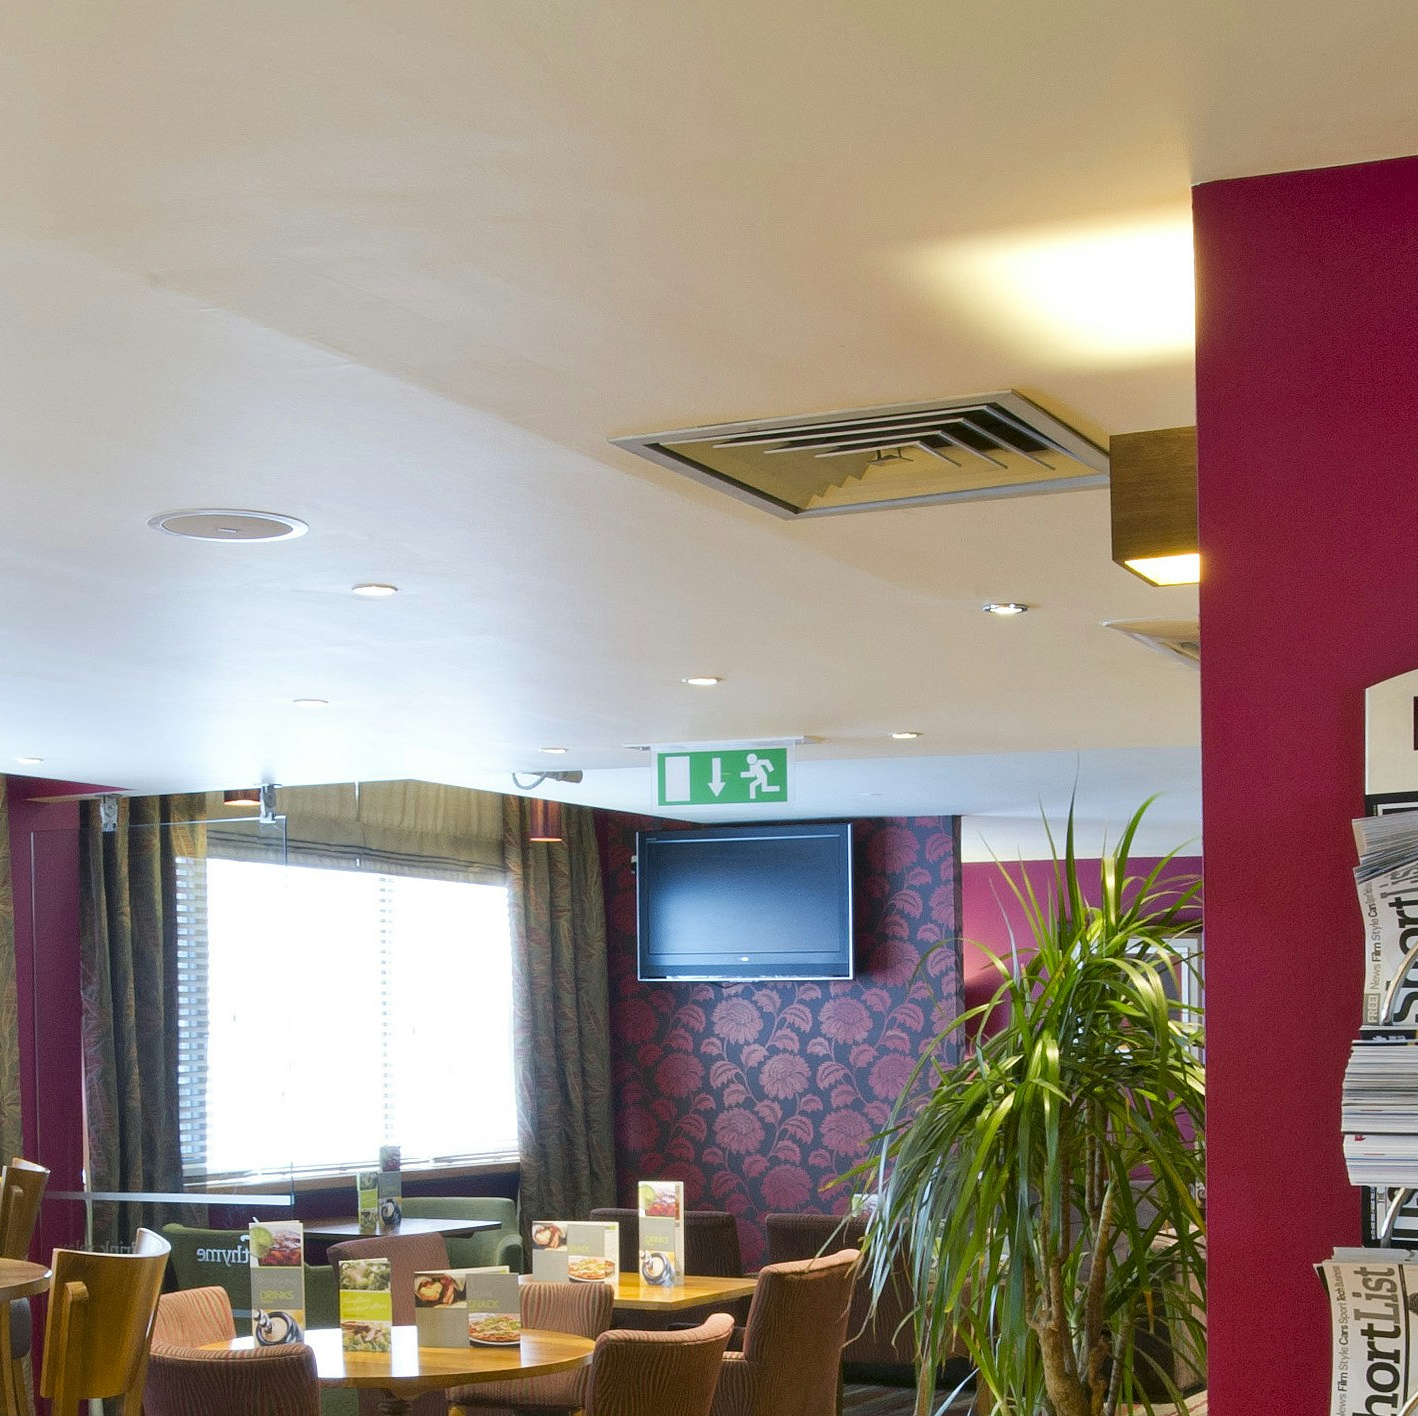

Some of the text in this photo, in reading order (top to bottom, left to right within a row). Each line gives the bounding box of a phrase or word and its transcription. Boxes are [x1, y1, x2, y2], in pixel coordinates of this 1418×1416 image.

[1372, 942, 1382, 962] Film
[1369, 963, 1381, 991] News
[259, 1289, 294, 1301] DRINKS
[1338, 1302, 1349, 1325] Sport
[1338, 1325, 1348, 1345] Cars
[1338, 1347, 1350, 1370] Style
[1337, 1372, 1348, 1392] Film
